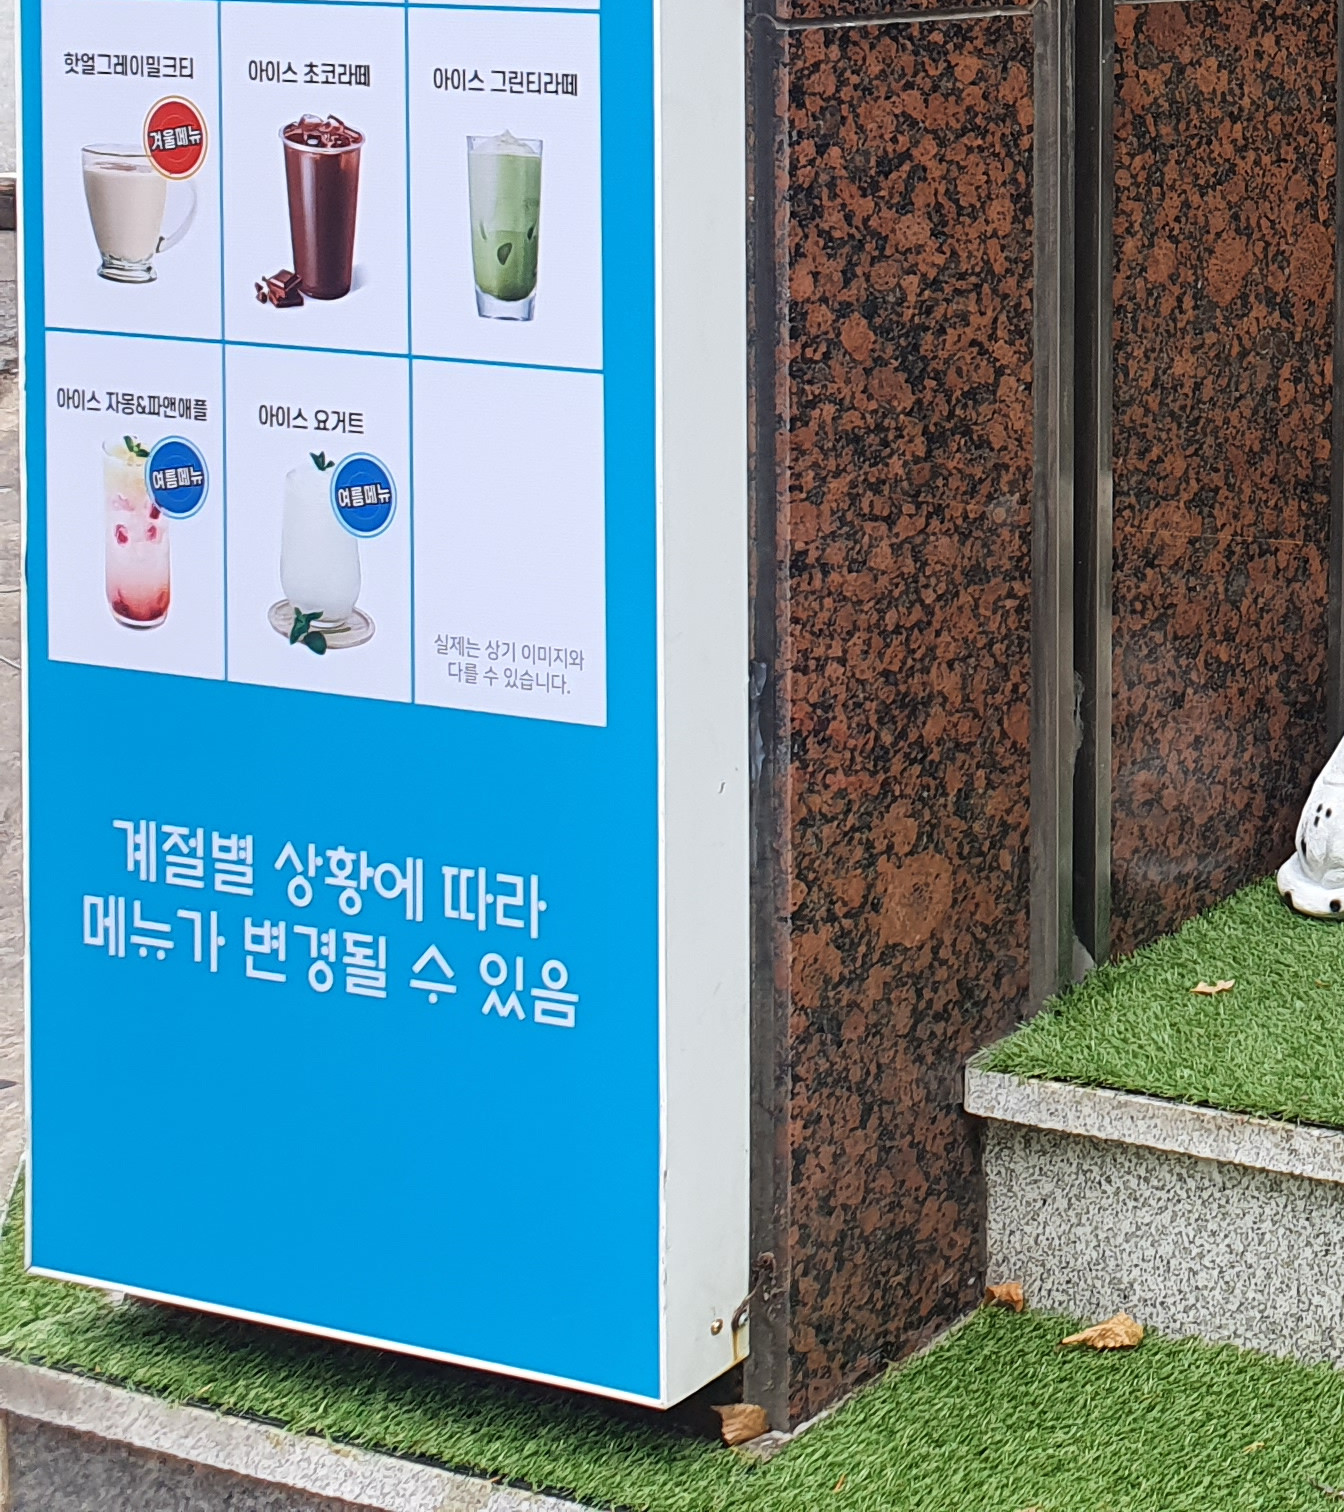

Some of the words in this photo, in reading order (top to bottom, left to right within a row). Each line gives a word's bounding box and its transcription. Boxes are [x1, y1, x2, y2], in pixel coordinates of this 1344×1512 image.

[64, 52, 193, 79] 핫얼그레이밀크티
[249, 60, 297, 83] 아이스
[304, 62, 370, 87] 초코라떼
[434, 68, 484, 91] 아이스
[491, 71, 577, 96] 그린티라떼
[149, 125, 202, 152] 겨울메뉴
[57, 388, 101, 411] 아이스
[259, 405, 308, 429] 아이스
[314, 410, 363, 434] 요거트
[152, 463, 204, 490] 여름메뉴
[337, 482, 391, 510] 여름메뉴
[434, 634, 481, 658] 실제는
[485, 640, 515, 662] 상기
[521, 644, 585, 671] 이미지와
[448, 661, 479, 684] 다를
[483, 667, 498, 686] 수
[503, 667, 571, 695] 있습니다.
[113, 819, 254, 897] 계절별
[274, 841, 424, 922] 상황에
[442, 866, 546, 938] 따라
[83, 895, 226, 972] 메뉴가
[244, 917, 387, 998] 변경될
[410, 946, 456, 1003] 수
[480, 954, 578, 1027] 있음
